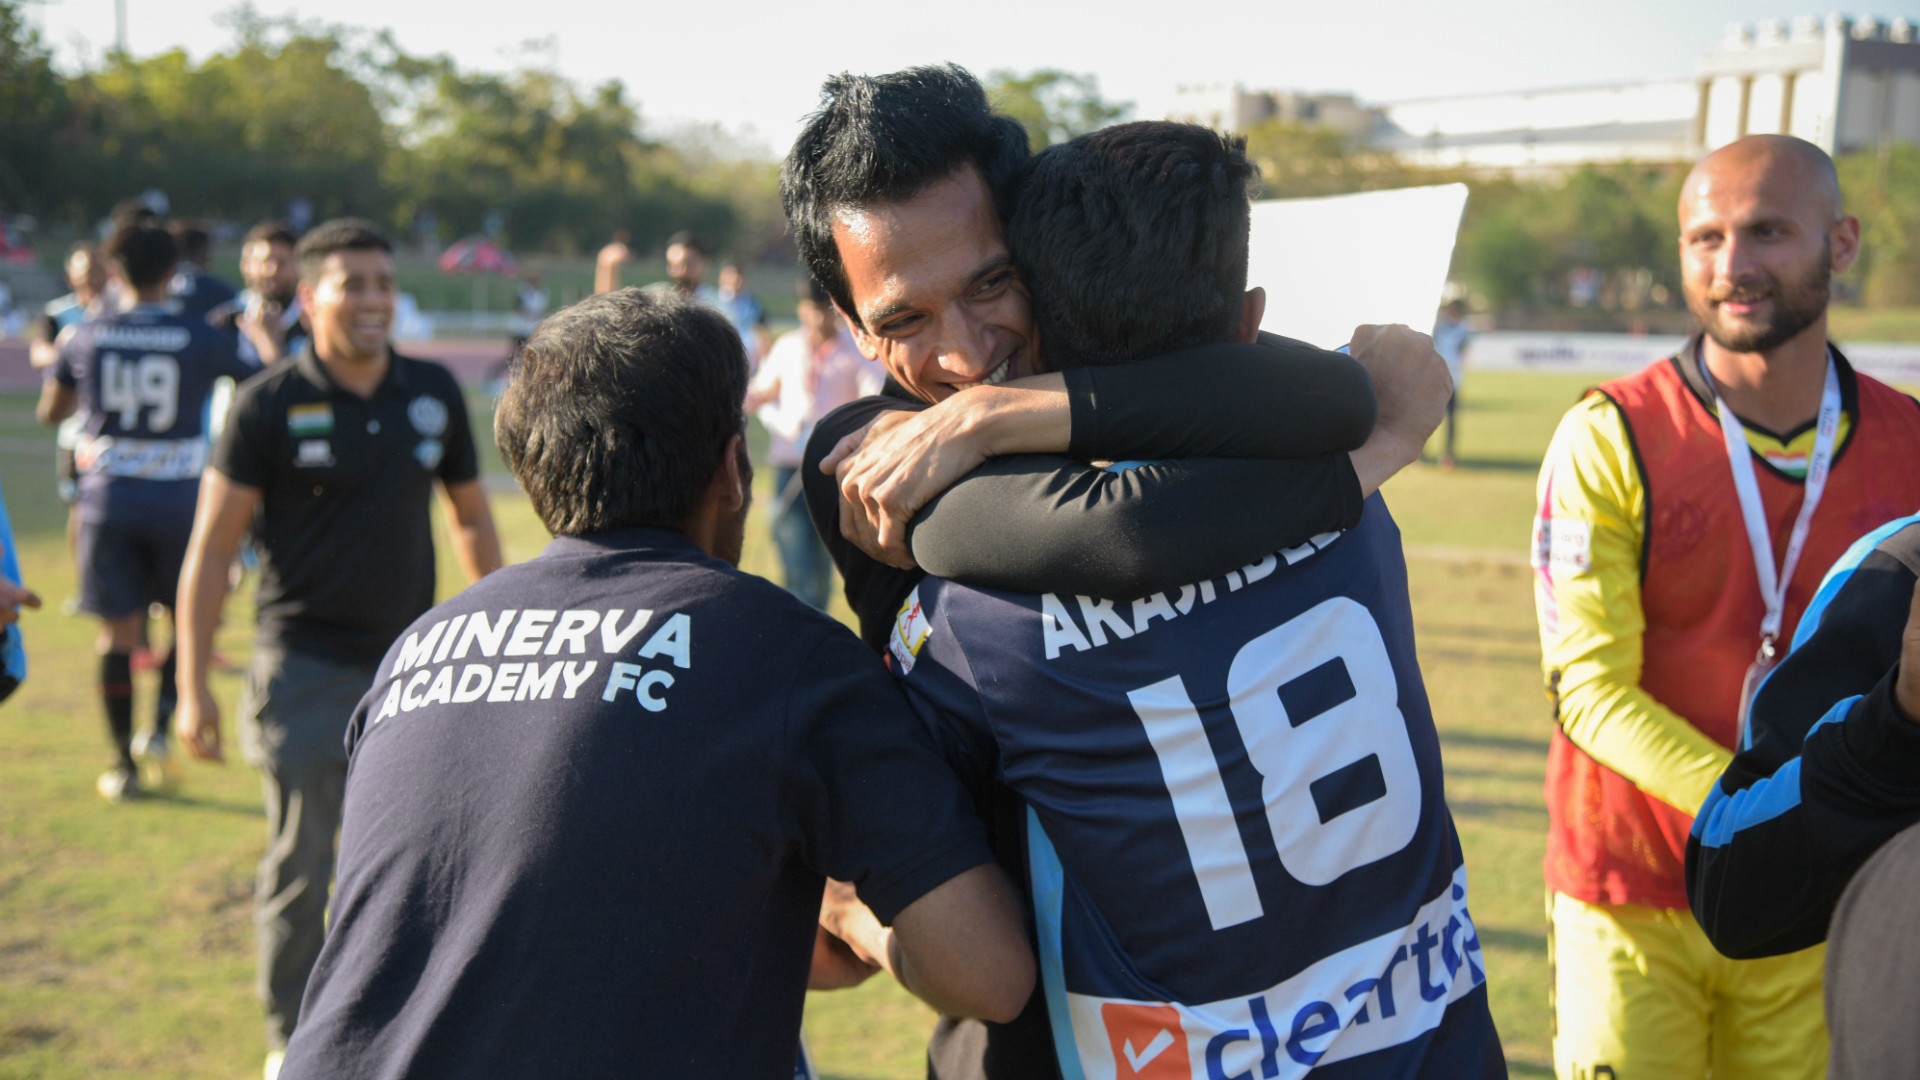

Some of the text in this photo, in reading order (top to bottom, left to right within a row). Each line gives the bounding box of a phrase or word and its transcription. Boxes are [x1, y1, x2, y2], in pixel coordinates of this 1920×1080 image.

[102, 352, 180, 433] 49
[389, 608, 691, 669] MINERVA
[374, 660, 675, 723] ACADEMY FC
[1126, 596, 1422, 931] 18
